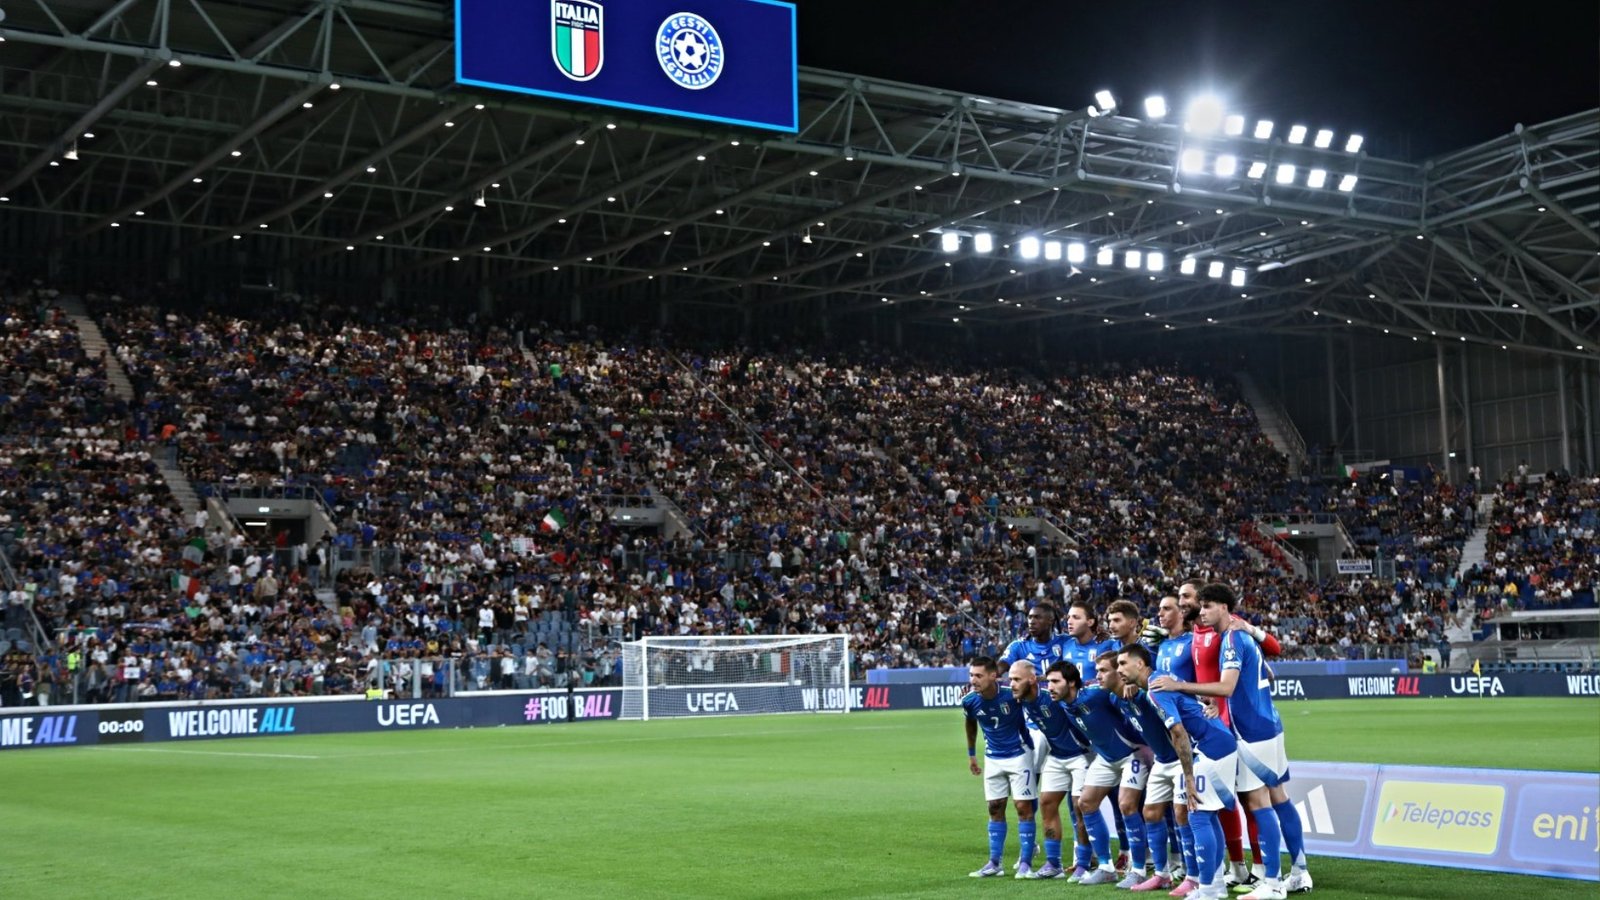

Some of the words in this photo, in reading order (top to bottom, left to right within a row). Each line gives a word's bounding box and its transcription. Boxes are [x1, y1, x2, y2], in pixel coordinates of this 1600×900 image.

[555, 2, 599, 24] ITALIA
[671, 17, 709, 35] EESTI
[921, 685, 965, 707] WELCO
[1348, 677, 1395, 696] WELCOME
[1396, 677, 1420, 695] ALL
[1450, 676, 1505, 696] UEFA
[524, 694, 613, 721] #FOOBALL
[686, 692, 739, 712] UEFA
[864, 687, 890, 708] ALL
[168, 708, 258, 737] WELCOME
[259, 707, 296, 733] ALL
[377, 703, 440, 726] UEFA
[990, 716, 999, 729] 7
[34, 715, 77, 744] ALL
[98, 719, 144, 734] 00:00
[1131, 759, 1140, 774] 8
[1023, 769, 1031, 786] 7
[1402, 801, 1493, 830] Telepass
[1532, 806, 1591, 842] eni
